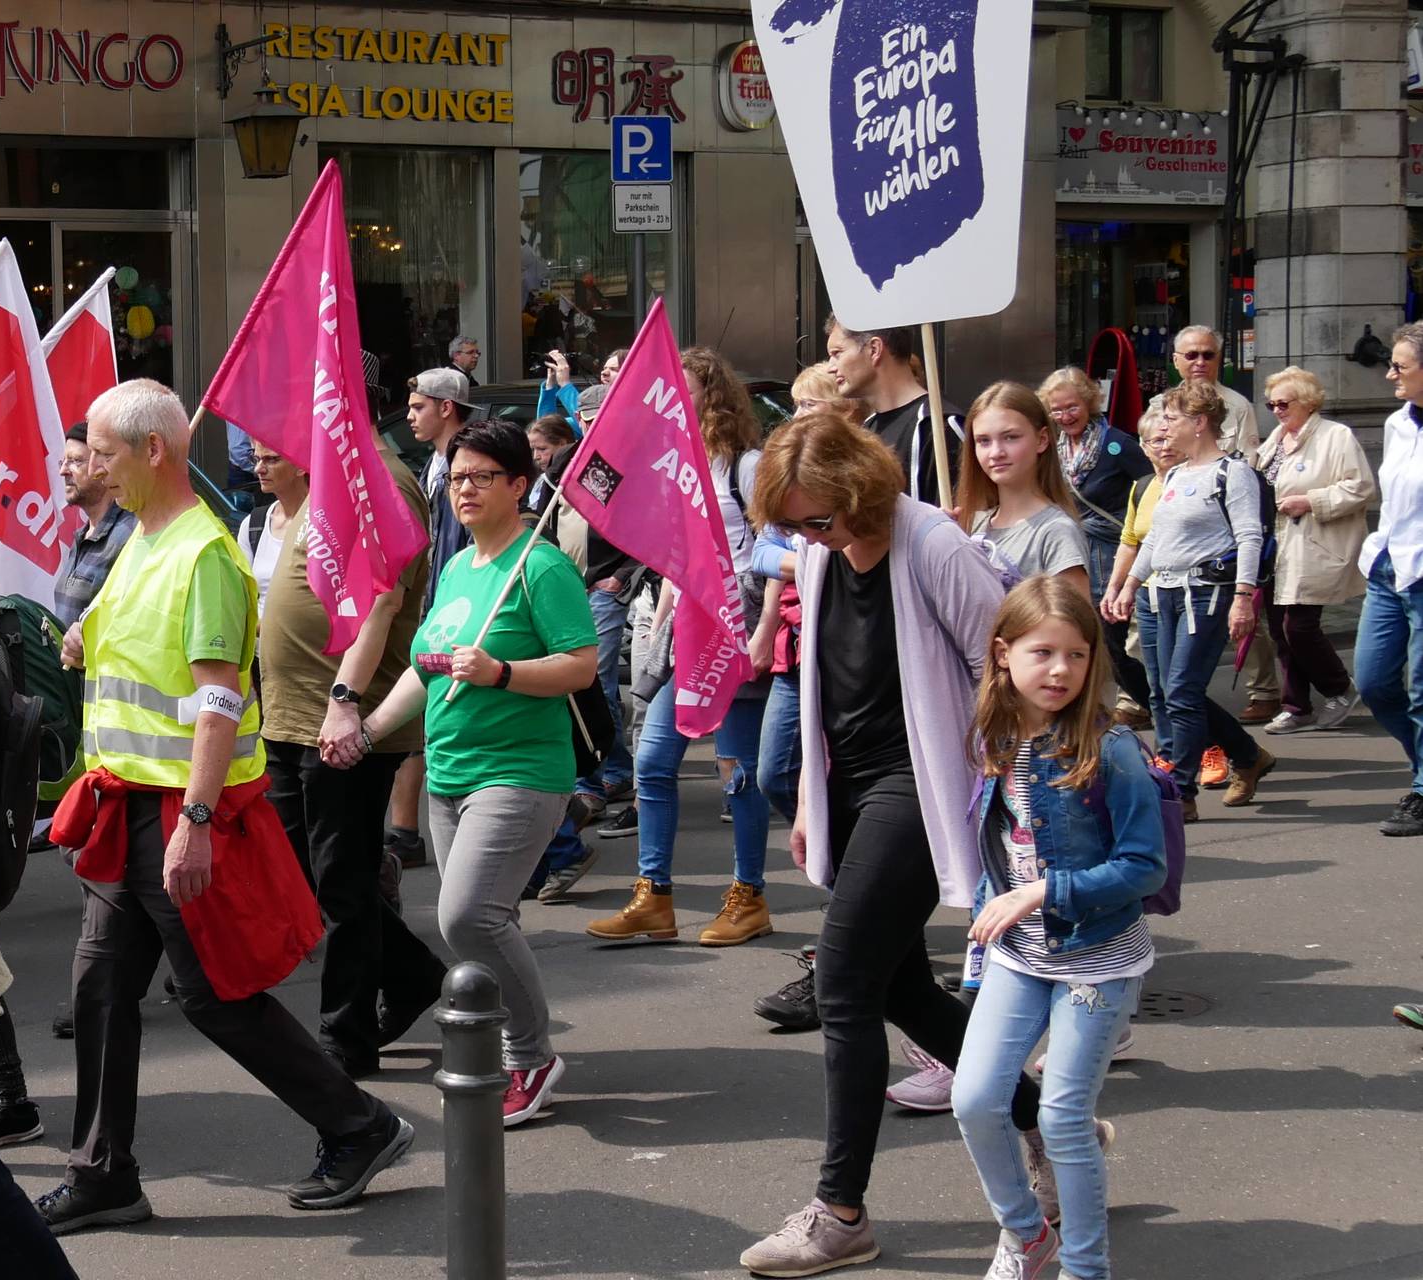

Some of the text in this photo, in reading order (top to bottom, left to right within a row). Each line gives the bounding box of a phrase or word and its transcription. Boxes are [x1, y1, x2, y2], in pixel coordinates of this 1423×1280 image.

[264, 23, 510, 66] RESTAURANT
[881, 23, 926, 69] Ein
[853, 39, 957, 118] Europa
[267, 82, 514, 122] SIA LOUNGE
[852, 94, 956, 159] für Alle
[1098, 129, 1218, 156] Souvenirs
[622, 125, 654, 174] P
[1146, 156, 1227, 173] Geschenke
[642, 191, 653, 200] mit
[864, 145, 960, 217] wählen
[618, 215, 646, 226] werktags
[647, 215, 652, 223] 9
[656, 214, 664, 224] 23
[665, 215, 670, 223] h
[625, 203, 660, 212] Parkschein
[313, 508, 340, 551] Bewegt
